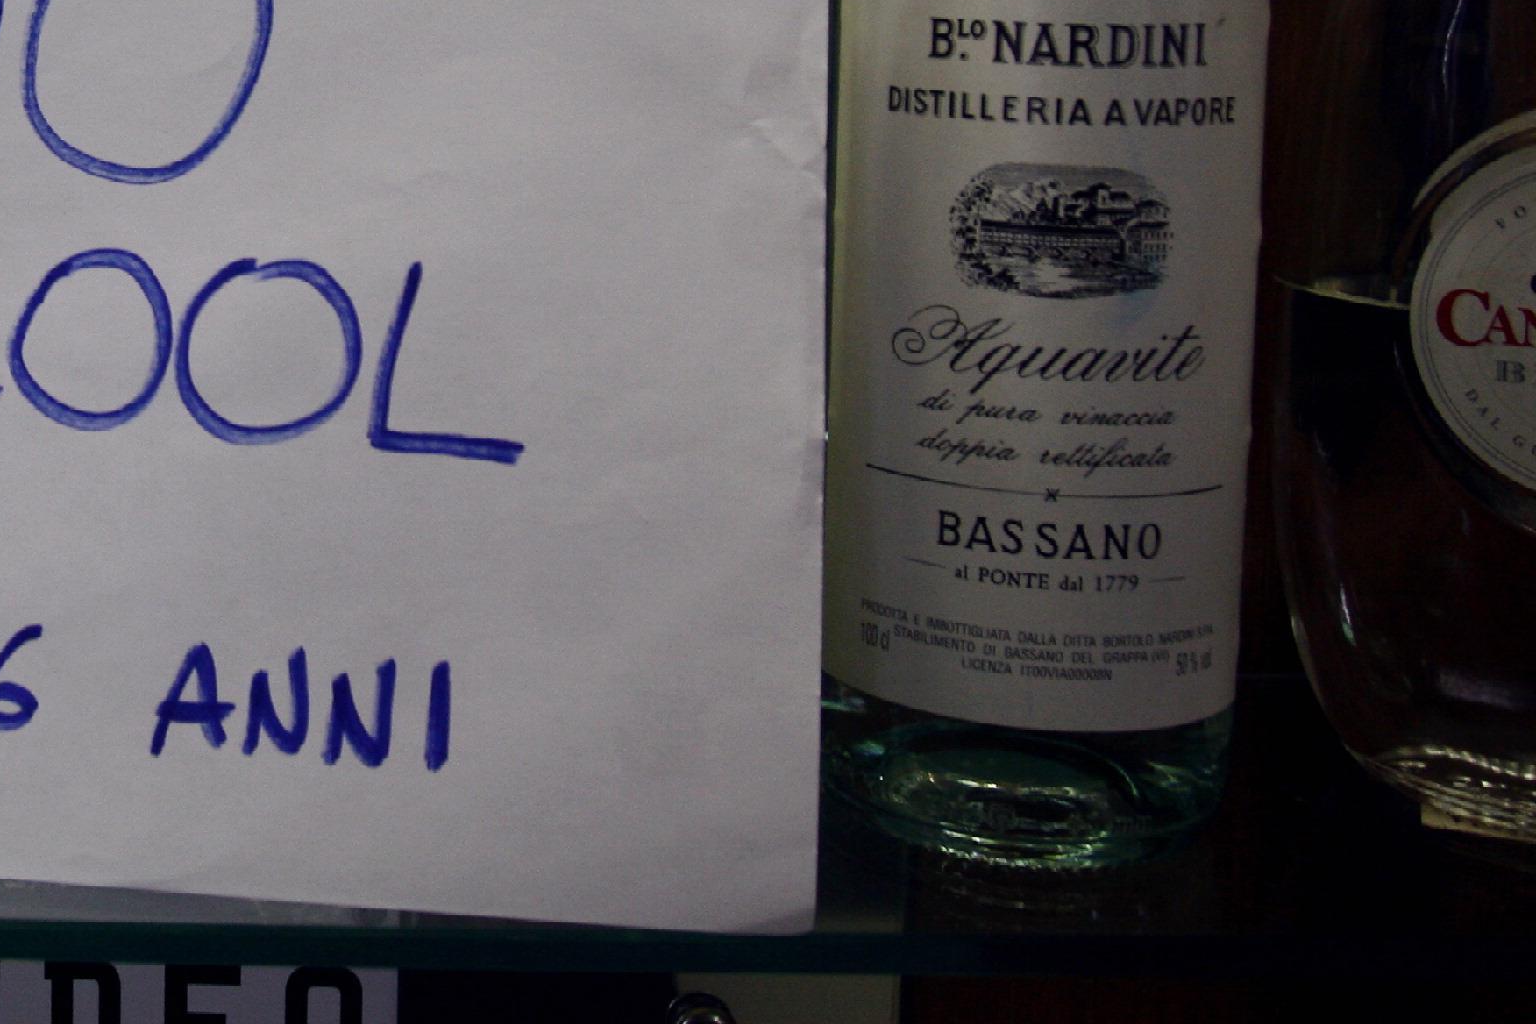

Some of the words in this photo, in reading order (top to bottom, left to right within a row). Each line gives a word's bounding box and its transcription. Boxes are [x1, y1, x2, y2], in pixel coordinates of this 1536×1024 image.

[991, 19, 1209, 69] NARDINI
[887, 85, 1093, 127] DISTILLERIA
[1103, 98, 1128, 127] A
[1132, 95, 1237, 127] VAPORE
[891, 304, 1207, 395] Aquavite
[916, 388, 952, 412] di
[957, 398, 1043, 426] pura
[1058, 406, 1177, 427] vinaccia
[916, 428, 1020, 466] doppia
[1038, 437, 1177, 479] rettificata
[936, 509, 1163, 562] BASSANO
[954, 565, 970, 581] al
[977, 567, 1051, 592] PONTE
[1058, 573, 1084, 593] dal
[1094, 573, 1141, 593] 1779
[151, 640, 452, 773] ANNI
